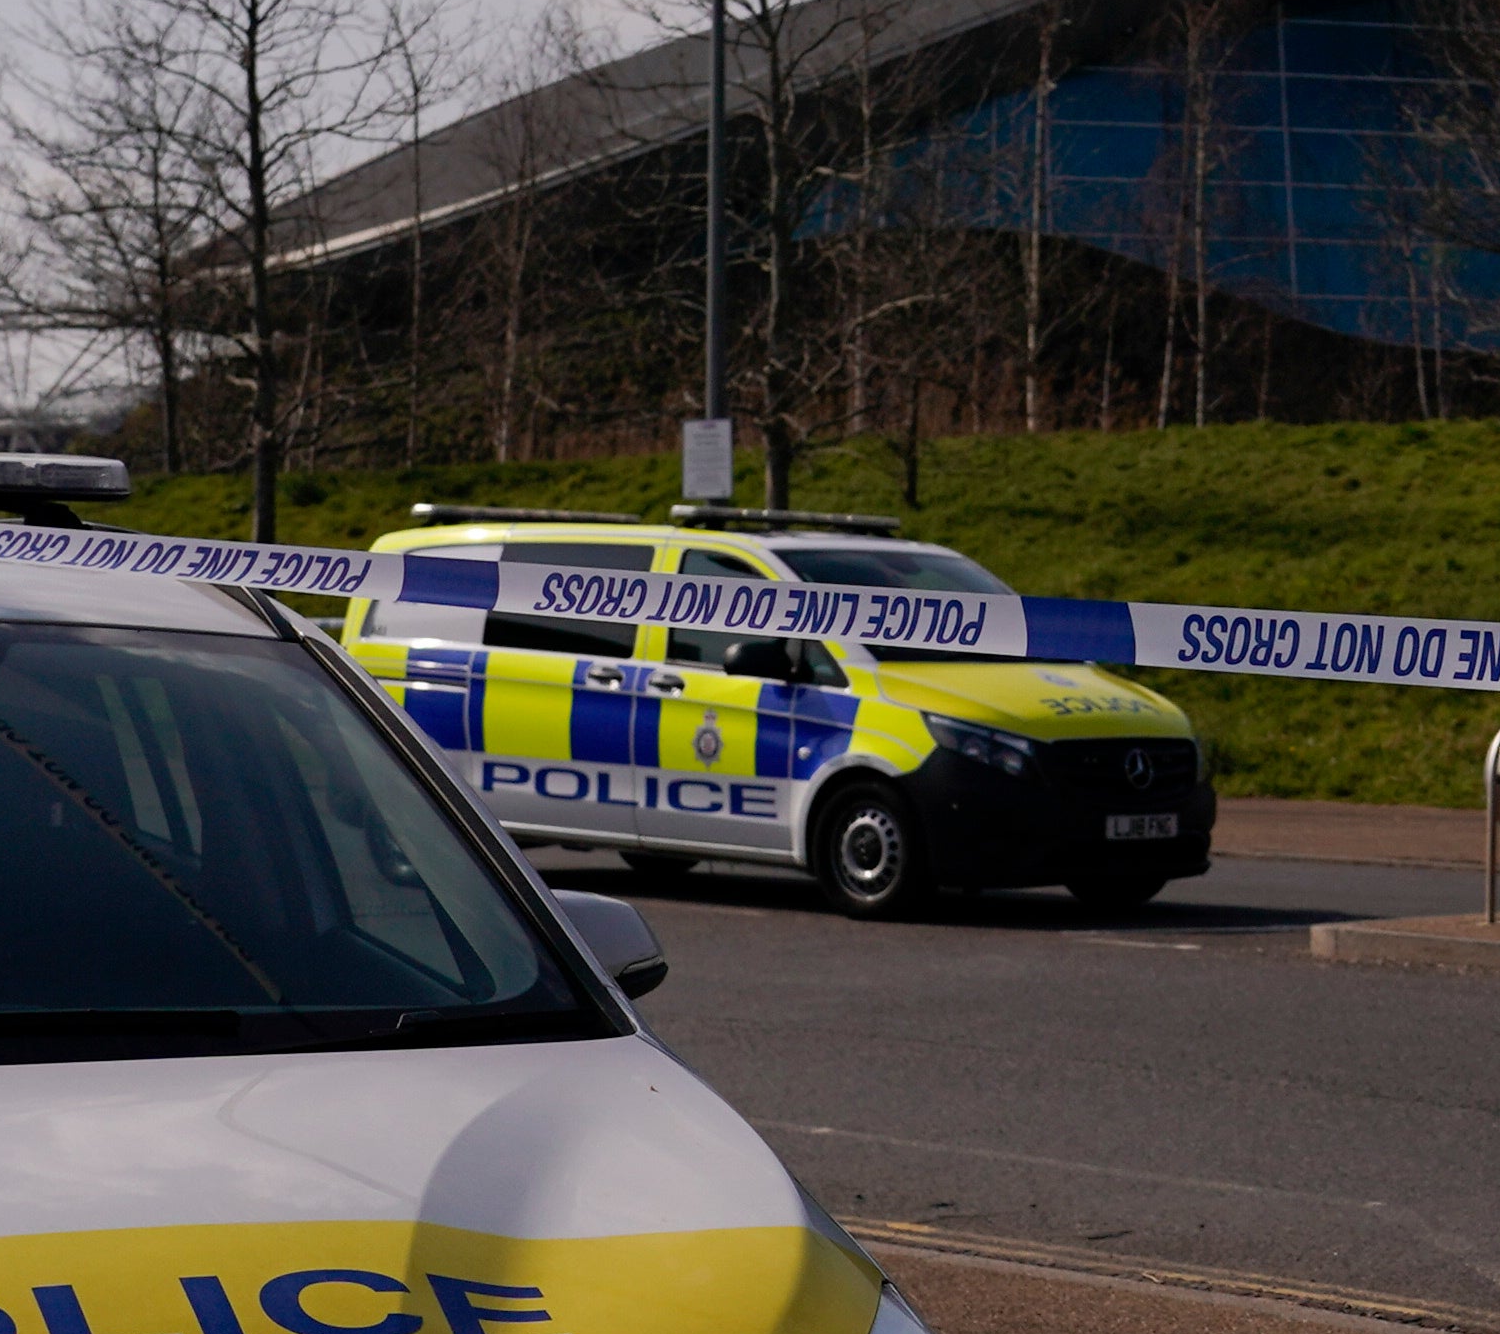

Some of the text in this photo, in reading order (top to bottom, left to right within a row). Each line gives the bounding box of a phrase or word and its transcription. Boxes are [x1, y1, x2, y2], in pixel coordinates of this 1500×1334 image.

[63, 536, 137, 569] NOT
[131, 543, 186, 576] DO
[183, 547, 262, 581] LINE
[261, 552, 372, 594] POLICE
[534, 572, 987, 646] POLICE LINE DO NOT CROSS
[1179, 613, 1300, 668] CROSS
[1306, 621, 1385, 673] NOT
[1393, 626, 1449, 679] DO
[481, 760, 778, 819] POLICE
